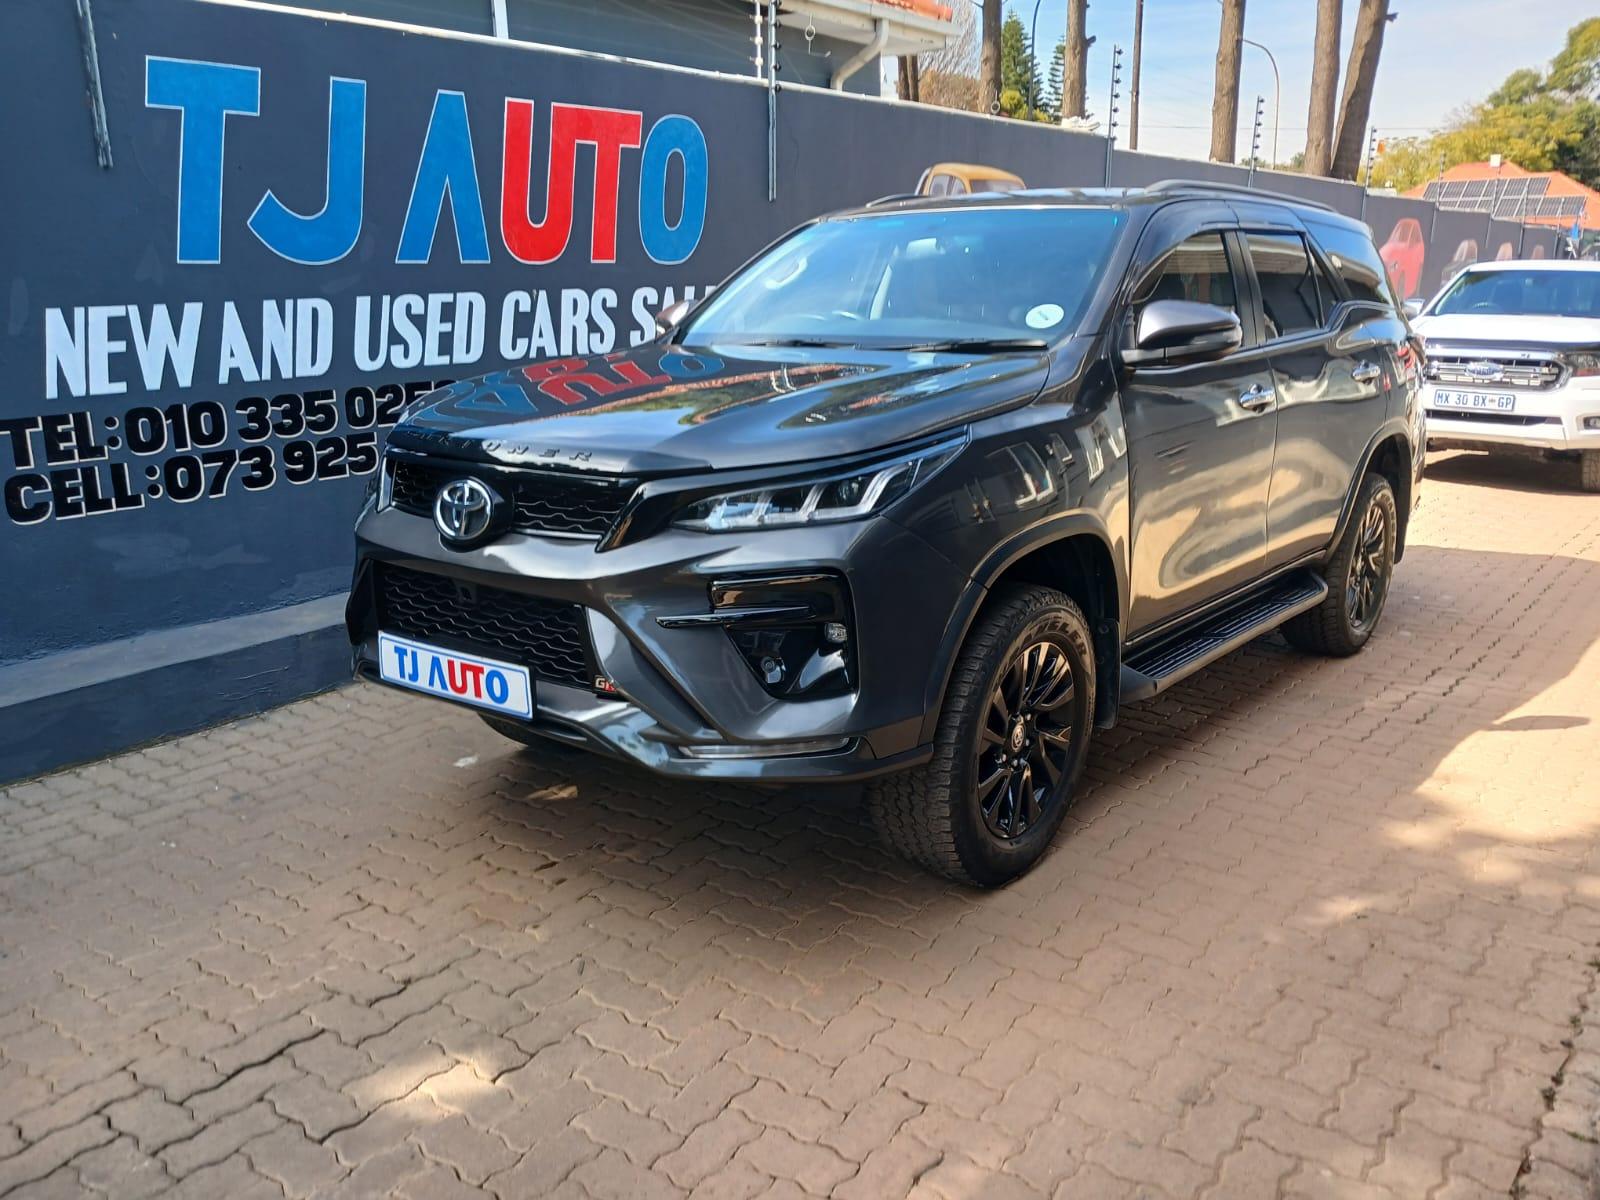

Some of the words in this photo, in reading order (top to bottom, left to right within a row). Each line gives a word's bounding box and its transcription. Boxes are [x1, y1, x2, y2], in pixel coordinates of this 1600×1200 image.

[145, 55, 367, 265] TJ
[395, 89, 708, 265] AUTO
[45, 302, 203, 400] NEW
[218, 298, 334, 385] AND
[354, 291, 486, 372] USED
[500, 287, 618, 360] CARS
[235, 389, 339, 443] 335
[344, 379, 457, 433] 02
[1455, 394, 1468, 406] 30
[1473, 395, 1487, 407] BX
[1498, 397, 1512, 409] GP
[282, 431, 379, 485] 925
[394, 645, 419, 683] TJ
[428, 655, 509, 705] AUTO
